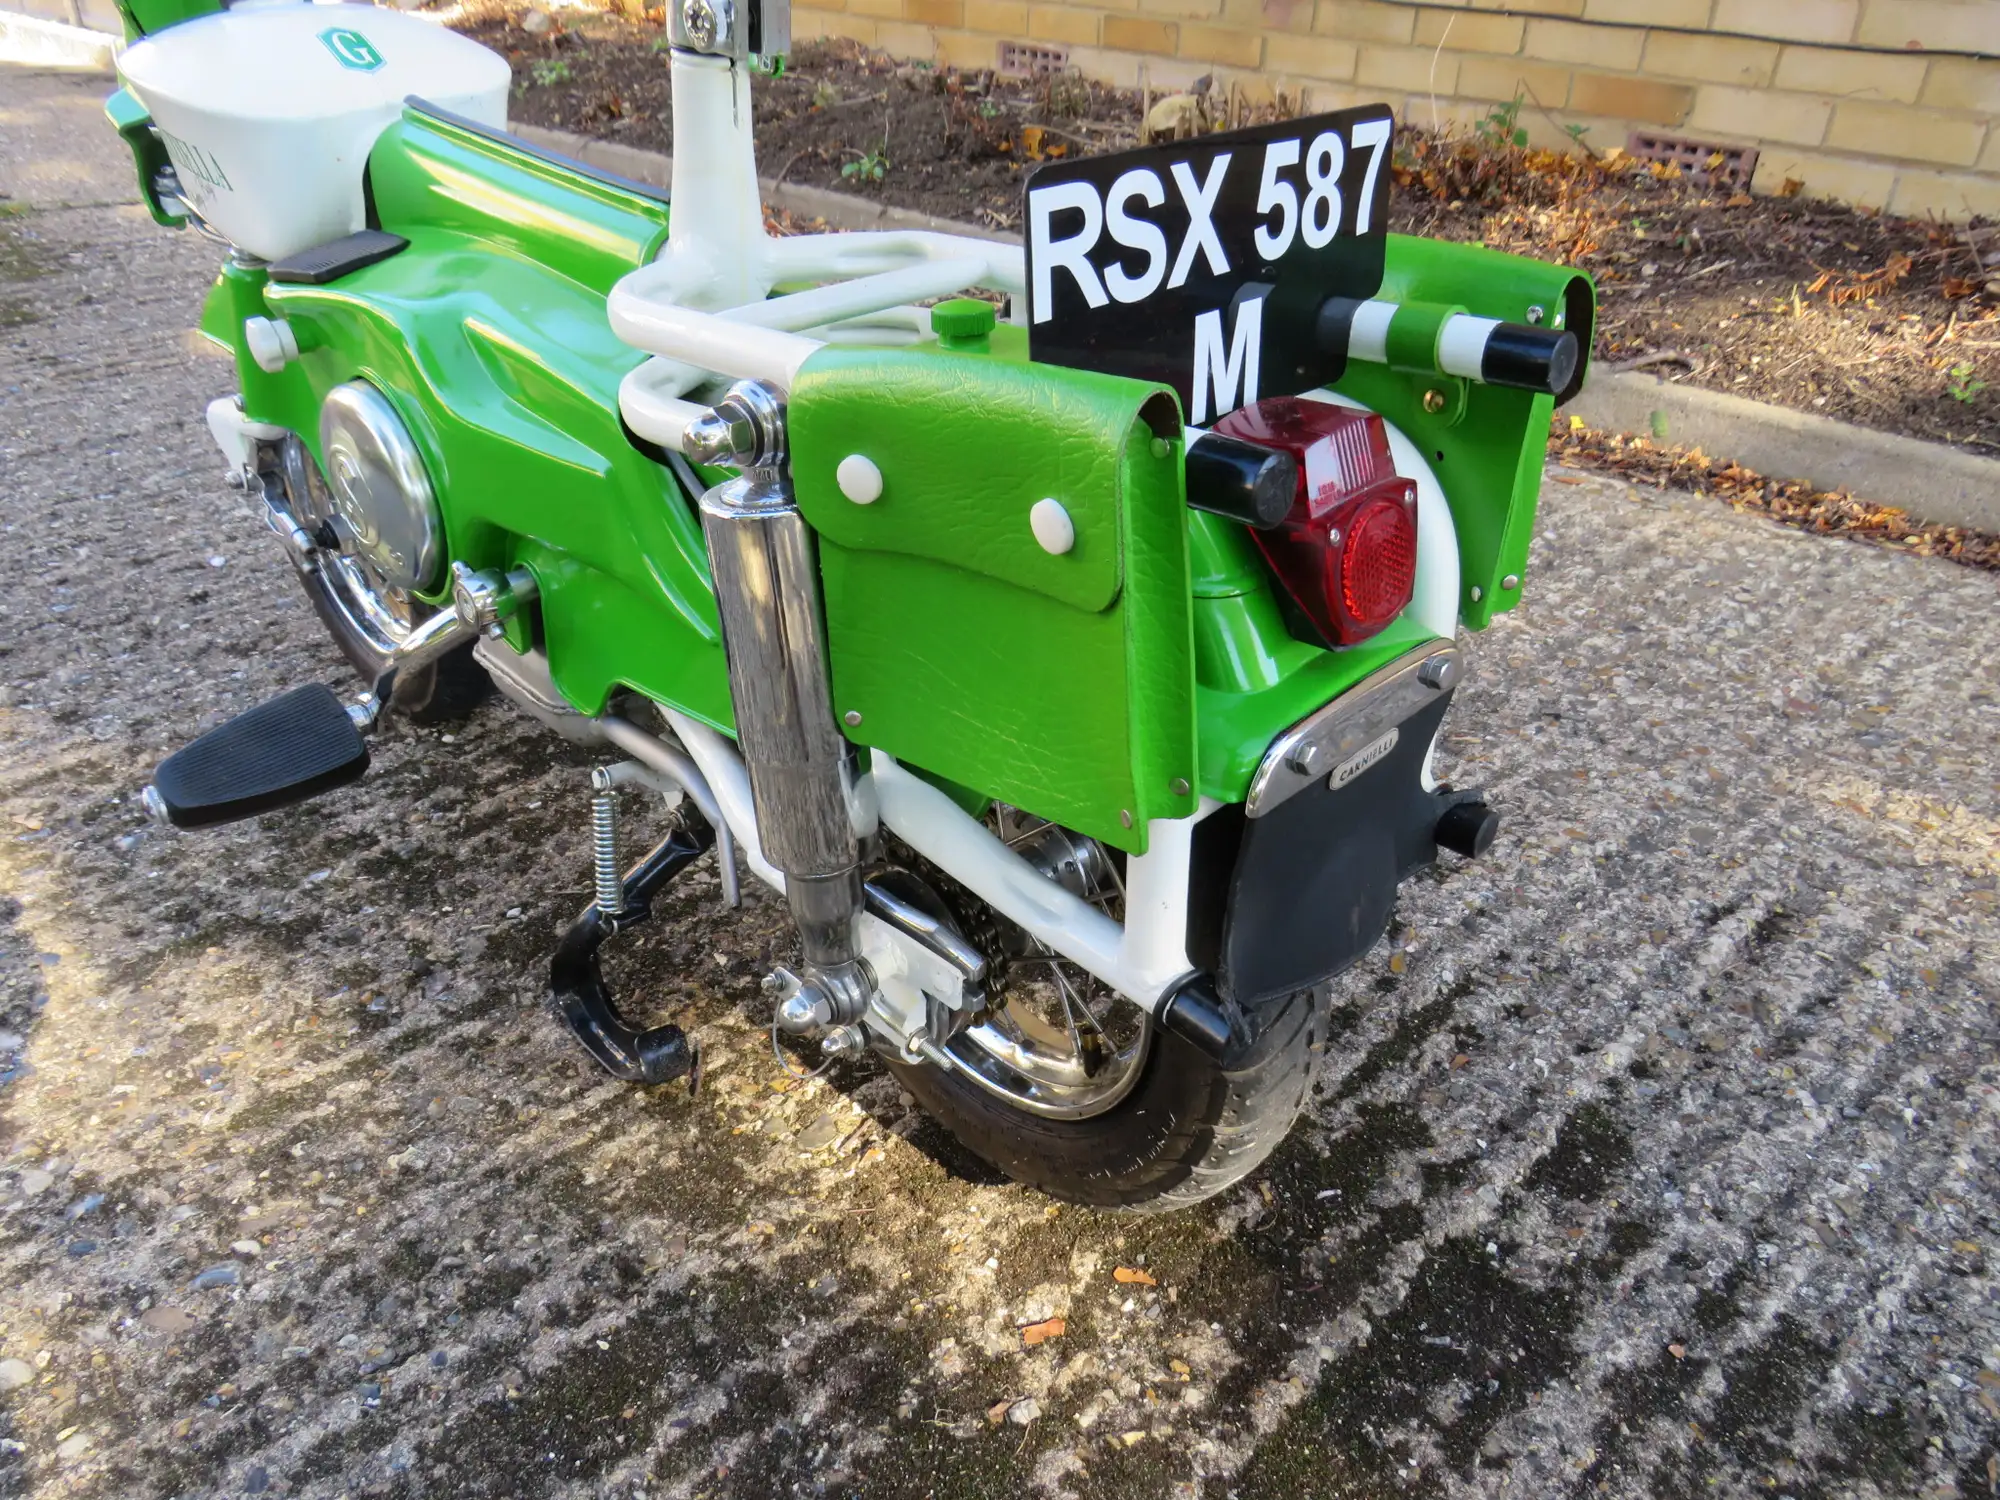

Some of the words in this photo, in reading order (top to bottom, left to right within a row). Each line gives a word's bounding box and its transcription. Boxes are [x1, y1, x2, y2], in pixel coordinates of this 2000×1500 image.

[1029, 152, 1233, 325] RSX
[1253, 118, 1392, 262] 587
[1190, 296, 1264, 427] M
[1339, 738, 1393, 782] CARNIELLI
